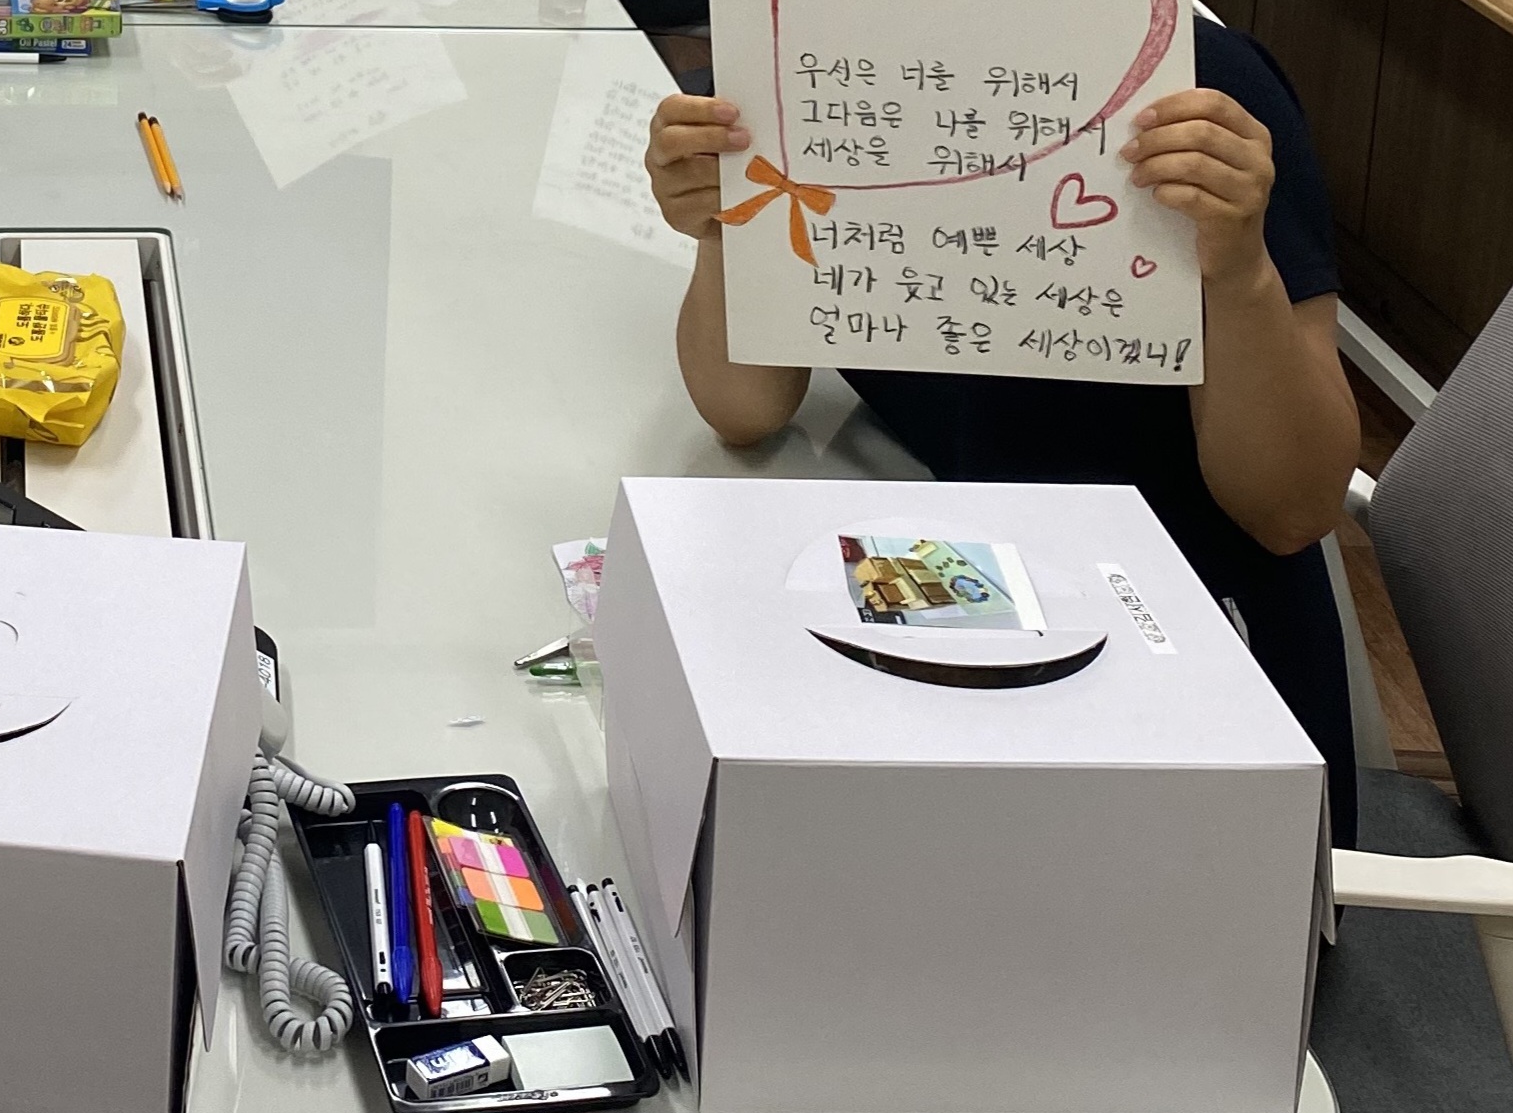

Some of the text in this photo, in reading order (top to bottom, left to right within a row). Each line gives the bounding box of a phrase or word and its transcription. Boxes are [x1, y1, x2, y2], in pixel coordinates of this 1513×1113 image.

[19, 38, 31, 47] Oil
[33, 38, 58, 48] Pastel
[796, 53, 1079, 100] 우선은 너를 위해서
[935, 110, 986, 140] 나를
[1008, 111, 1108, 155] 위해서
[802, 136, 1027, 182] 세상을 위해서
[811, 221, 1086, 266] 너처럼 예쁜 세상
[812, 266, 1124, 318] 네가 웃고 있는 세상은
[810, 305, 908, 344] 얼마나
[935, 314, 992, 355] 좋은
